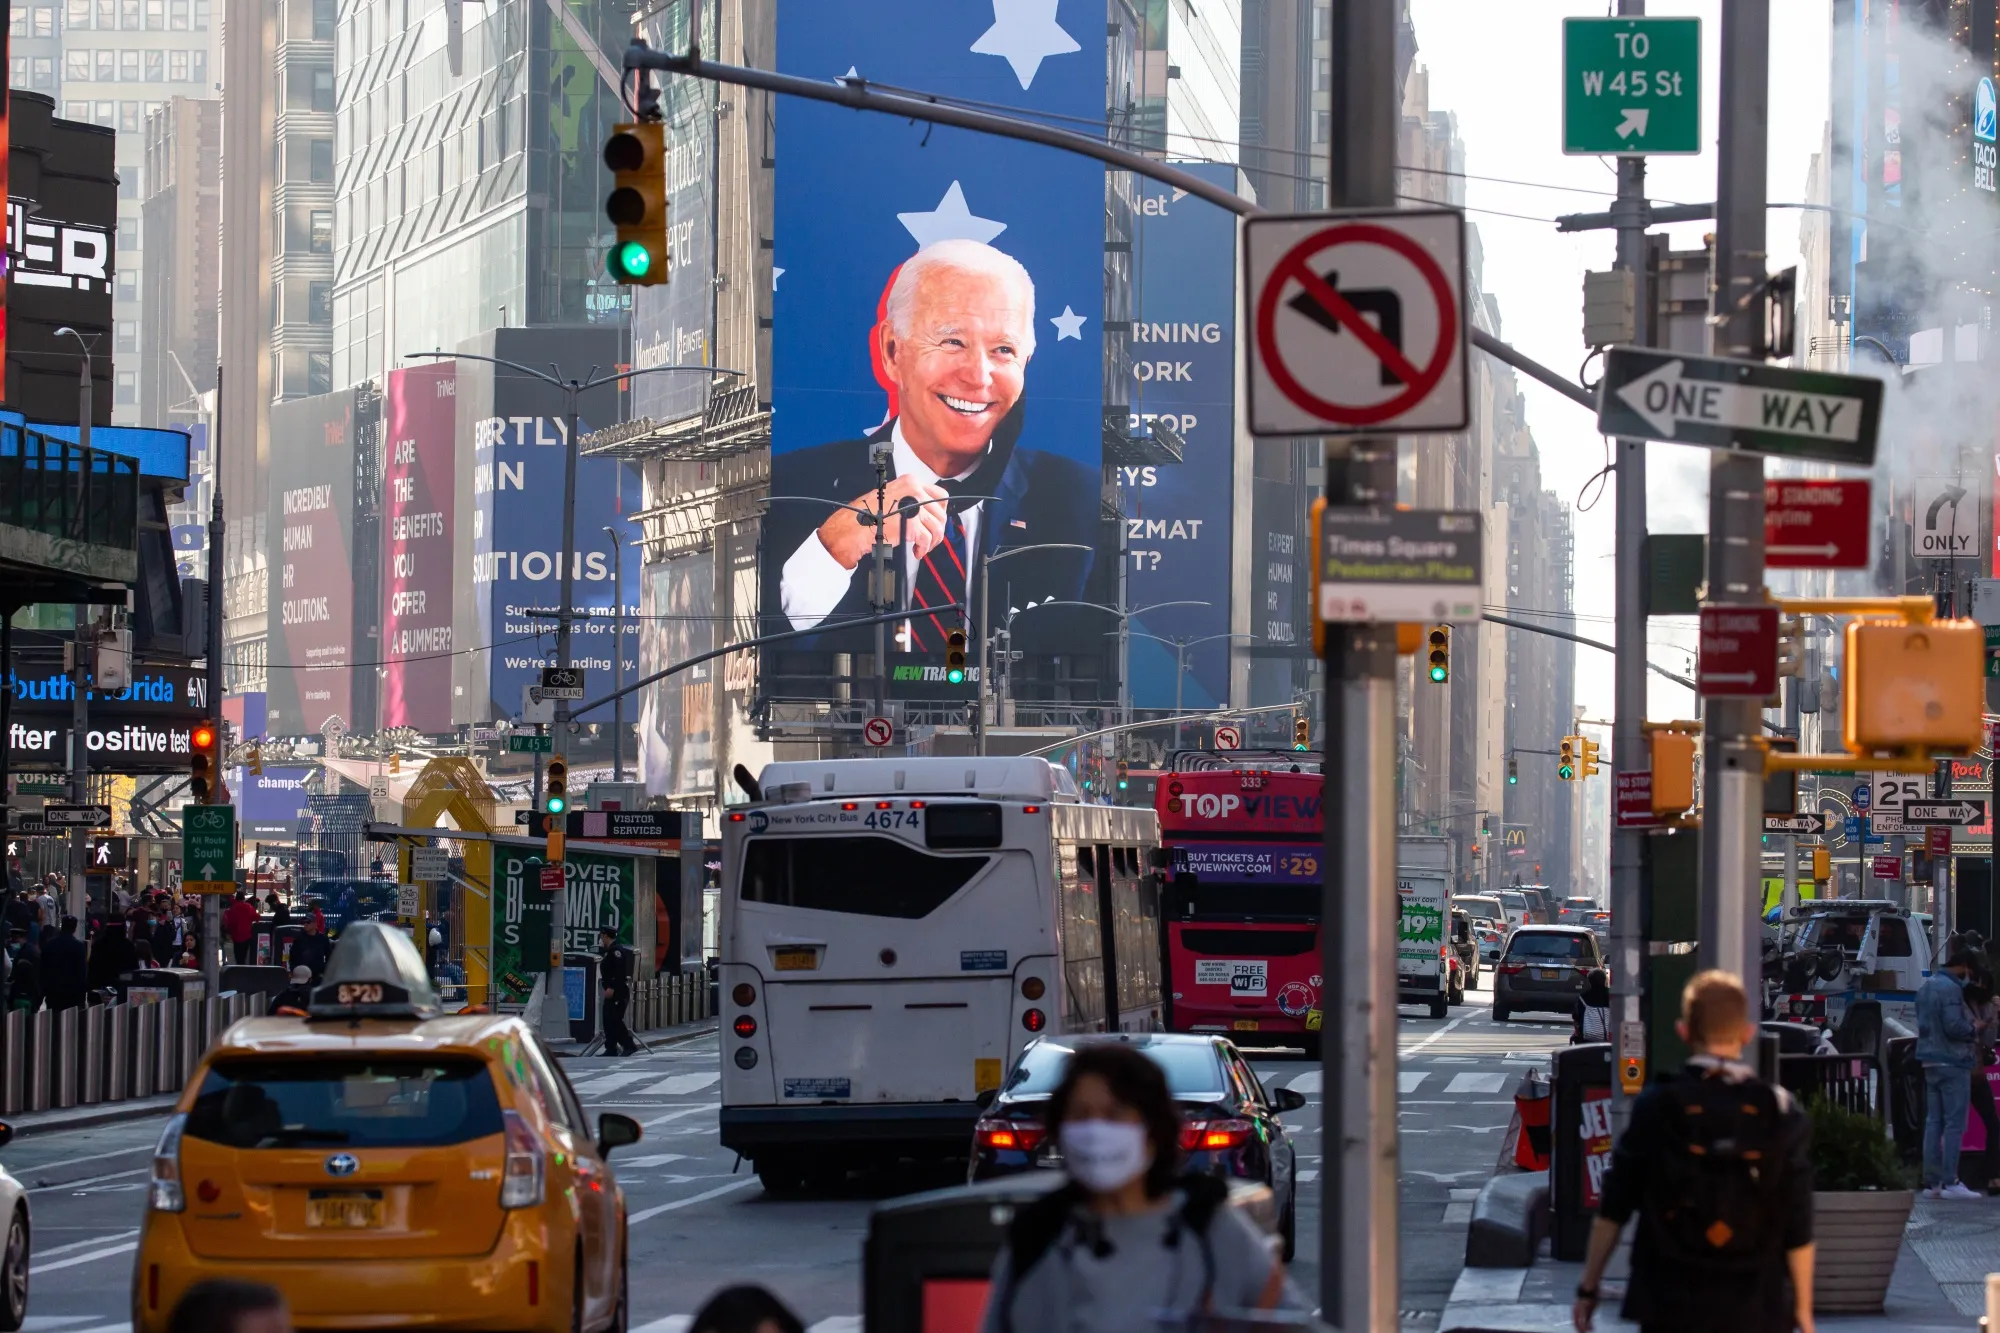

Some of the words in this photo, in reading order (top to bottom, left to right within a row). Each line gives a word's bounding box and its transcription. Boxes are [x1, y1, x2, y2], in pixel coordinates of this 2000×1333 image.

[1614, 33, 1650, 59] TO
[1582, 71, 1604, 96] W
[1608, 71, 1648, 97] 45
[1655, 71, 1683, 97] St
[1974, 141, 1997, 169] TACO
[1974, 165, 1996, 192] BELL
[635, 330, 671, 371] Montefiore
[1132, 360, 1193, 382] ORK
[436, 379, 456, 399] TriNet
[1644, 380, 1723, 421] ONE
[1761, 393, 1847, 434] WAY
[323, 421, 346, 447] TriNet
[393, 438, 415, 465] ARE
[474, 461, 525, 496] HUMAN
[283, 484, 332, 515] INCREDIBLY
[393, 477, 414, 503] THE
[393, 511, 444, 541] BENEFITS
[474, 510, 484, 539] HR
[282, 524, 313, 552] HUMAN
[1268, 532, 1294, 555] EXPERT
[1328, 535, 1385, 556] Times
[1387, 535, 1457, 559] Square
[1922, 535, 1971, 551] ONLY
[282, 564, 295, 589] HR
[393, 554, 414, 579] YOU
[473, 551, 617, 585] SOLUTIONS.
[1267, 562, 1293, 584] HUMAN
[281, 596, 331, 626] SOLUTIONS.
[392, 590, 426, 617] OFFER
[589, 604, 626, 617] smal
[1267, 590, 1278, 611] HR
[505, 622, 582, 635] busineses
[585, 622, 605, 634] for
[391, 635, 399, 654] A
[401, 626, 452, 653] BUMMER?
[550, 657, 611, 671] snding
[187, 685, 197, 698] abc
[543, 688, 560, 697] BIKE
[562, 688, 584, 698] LANE
[86, 725, 167, 752] ositive
[169, 728, 190, 754] test
[513, 737, 523, 750] W
[527, 738, 540, 751] 45
[16, 773, 66, 786] COFFEE
[1951, 761, 1984, 780] Rock
[372, 787, 388, 797] 25
[1241, 777, 1262, 788] 333
[1618, 776, 1630, 788] NO
[1879, 781, 1921, 806] 25
[49, 811, 71, 822] ONE
[81, 811, 103, 822] WAY
[1179, 793, 1240, 819] TOP
[1243, 794, 1322, 819] VIEW
[1914, 807, 1938, 818] ONE
[1948, 806, 1974, 818] WAY
[613, 814, 655, 824] VISITOR
[771, 815, 792, 825] New
[794, 815, 816, 825] York
[818, 813, 837, 825] City
[839, 812, 859, 822] Bus
[864, 811, 920, 830] 4674
[1771, 818, 1789, 828] ONE
[1797, 818, 1816, 829] WAY
[191, 836, 203, 845] Alt
[204, 836, 227, 845] Route
[613, 826, 662, 836] SERVICES
[193, 847, 224, 859] South
[1186, 852, 1209, 862] BUY
[1210, 852, 1254, 863] TICKETS
[1256, 853, 1272, 863] AT
[507, 858, 621, 882] DOVER
[213, 883, 225, 891] AVE
[1402, 895, 1421, 903] OWEST
[1426, 916, 1439, 924] 95
[1234, 965, 1264, 975] FREE
[1299, 984, 1308, 993] ON
